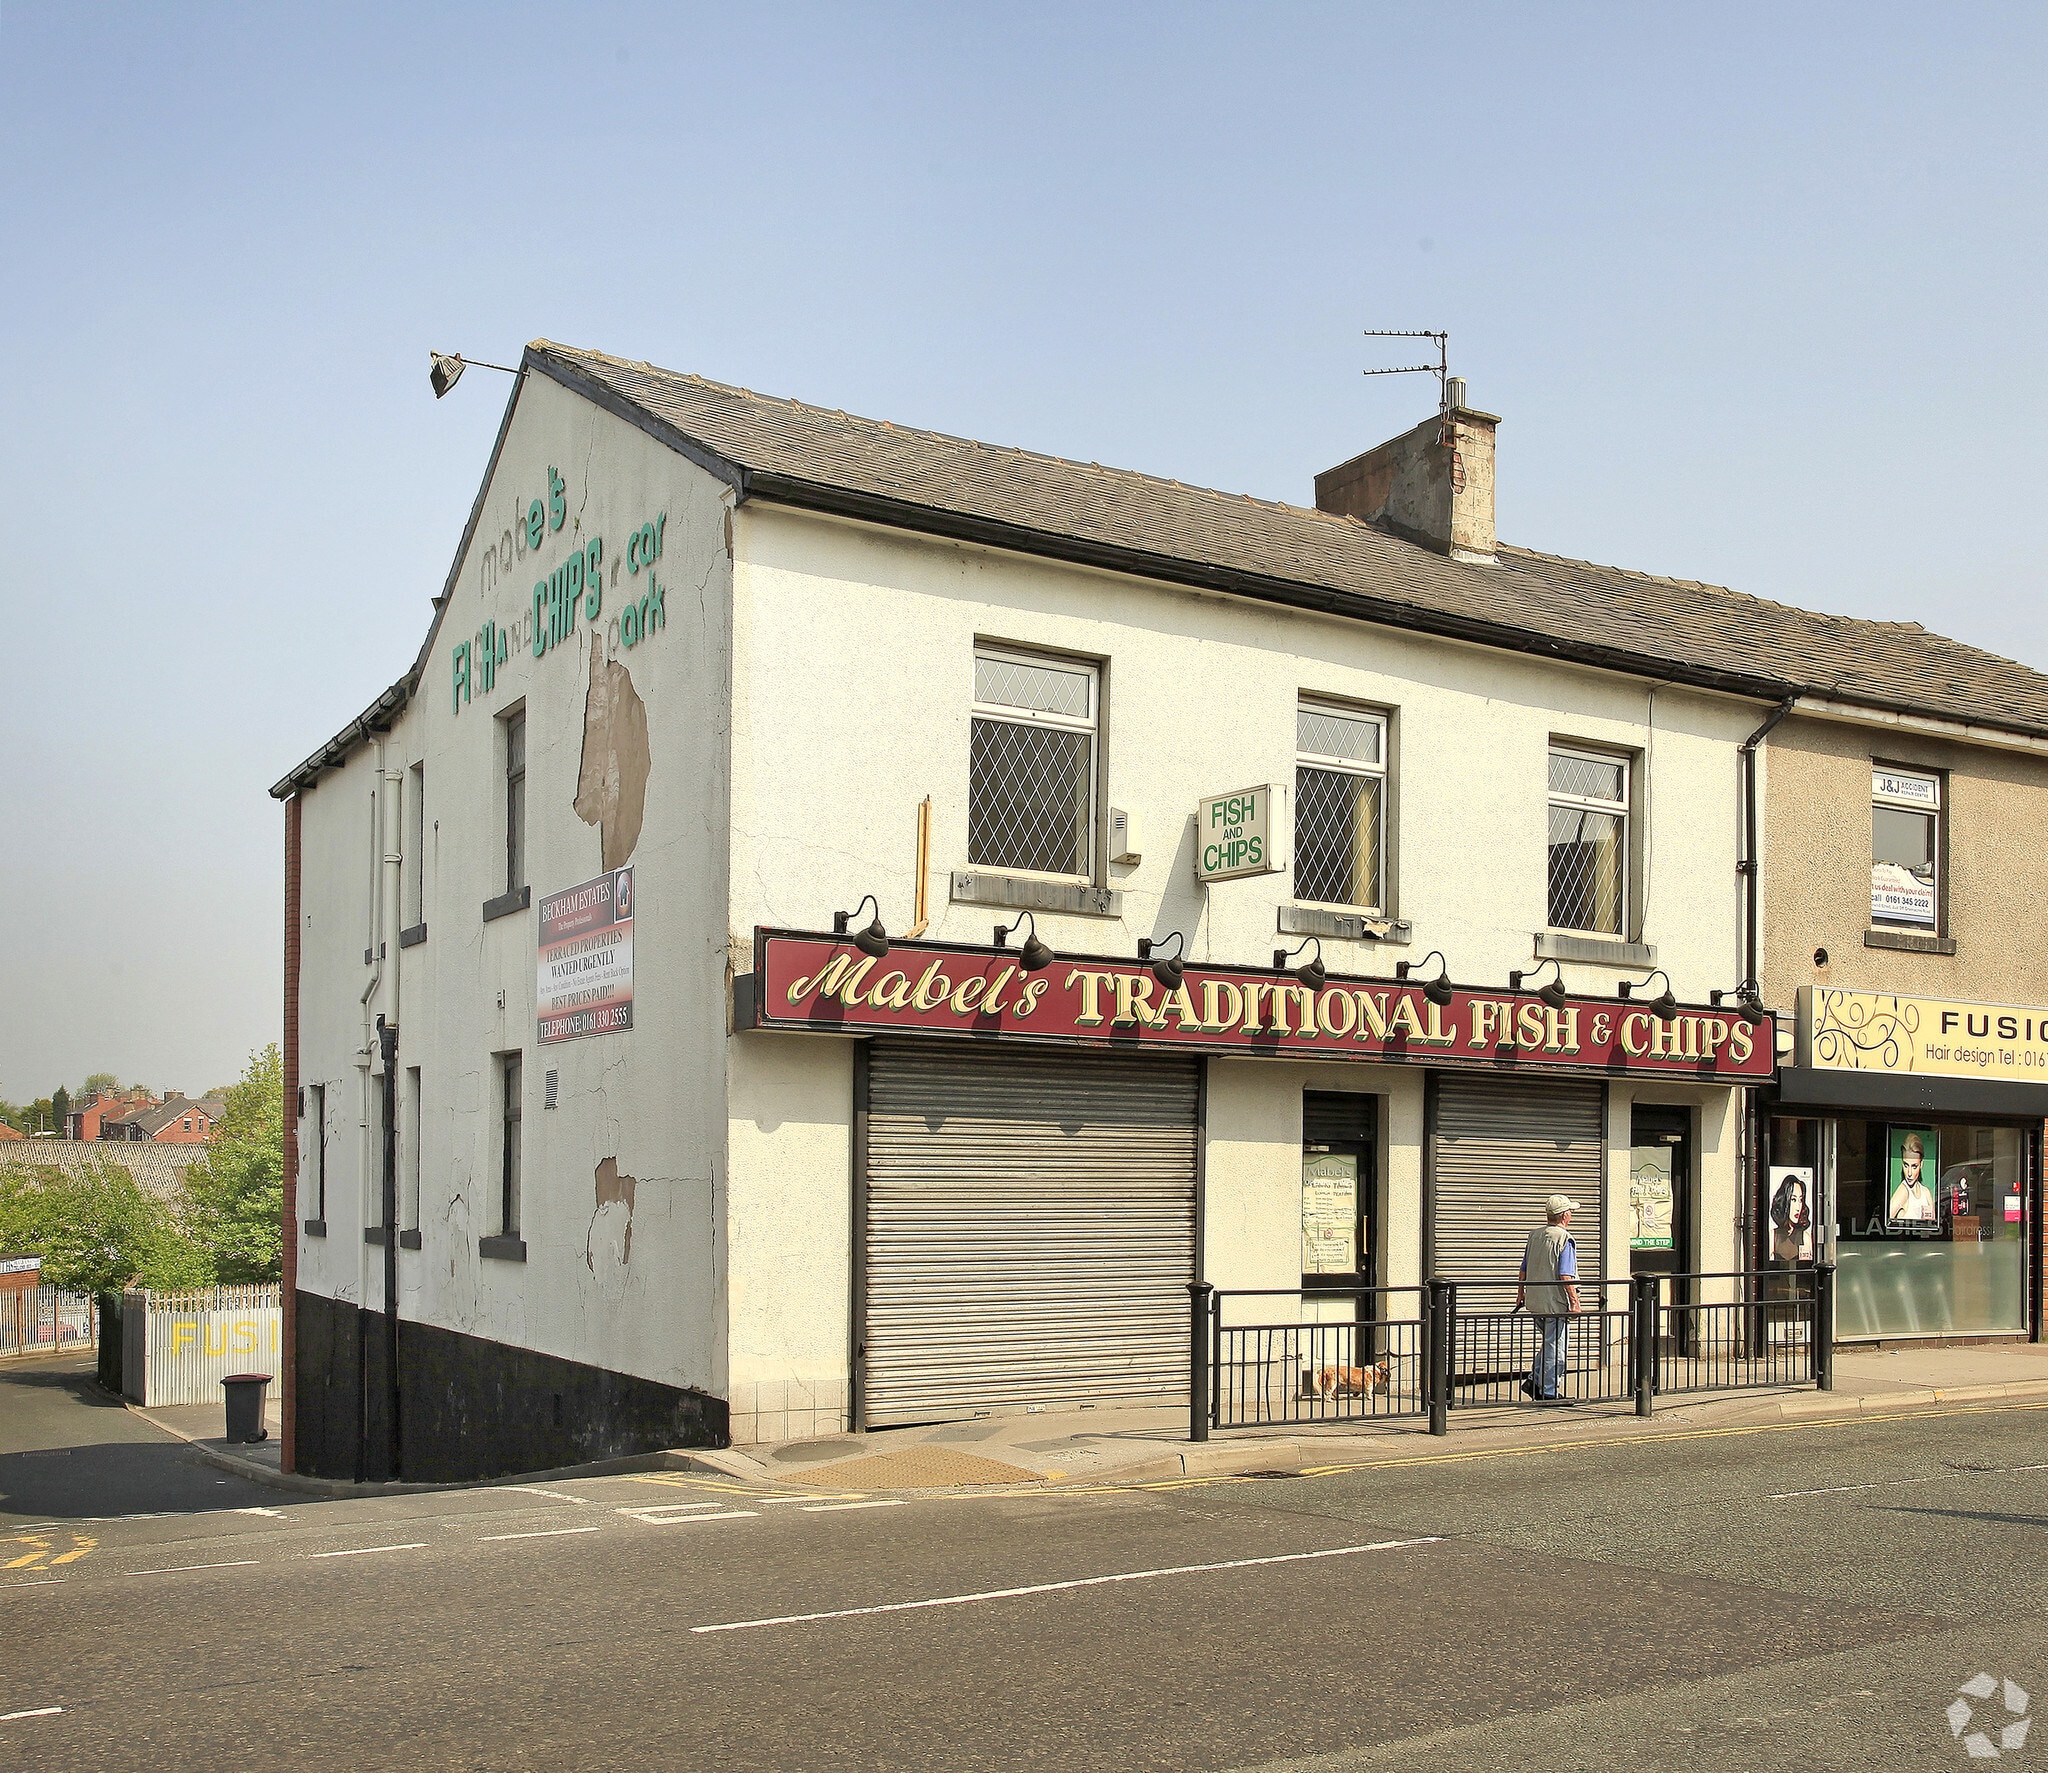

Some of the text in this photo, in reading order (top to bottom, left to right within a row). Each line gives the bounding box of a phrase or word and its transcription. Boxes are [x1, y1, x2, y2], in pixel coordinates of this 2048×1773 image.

[453, 619, 495, 715] FISH
[533, 537, 602, 658] CHIPS
[1880, 778, 1900, 794] J&J
[1901, 782, 1929, 793] ACCIDENT
[1211, 794, 1255, 829] FISH
[1222, 826, 1243, 840] AND
[1203, 836, 1262, 872] CHIPS
[542, 882, 612, 923] BECKHAM ESTATES
[1885, 895, 1900, 904] 0161
[1901, 897, 1914, 905] 345
[1914, 899, 1929, 908] 2222
[546, 928, 623, 963] TERRACED PROPERTIES
[551, 949, 616, 979] WANTED URGENTLY
[551, 984, 615, 1011] BEST PRICES PAID!!!
[787, 952, 1754, 1066] Mabel's TRADITIONAL FISH & CHIPS
[540, 1006, 628, 1039] TELEPHONE: 0161 330 2555
[1926, 1043, 1951, 1061] Hair
[1954, 1045, 1995, 1067] design
[2024, 1050, 2048, 1068] 016
[1656, 1238, 1671, 1246] STEP
